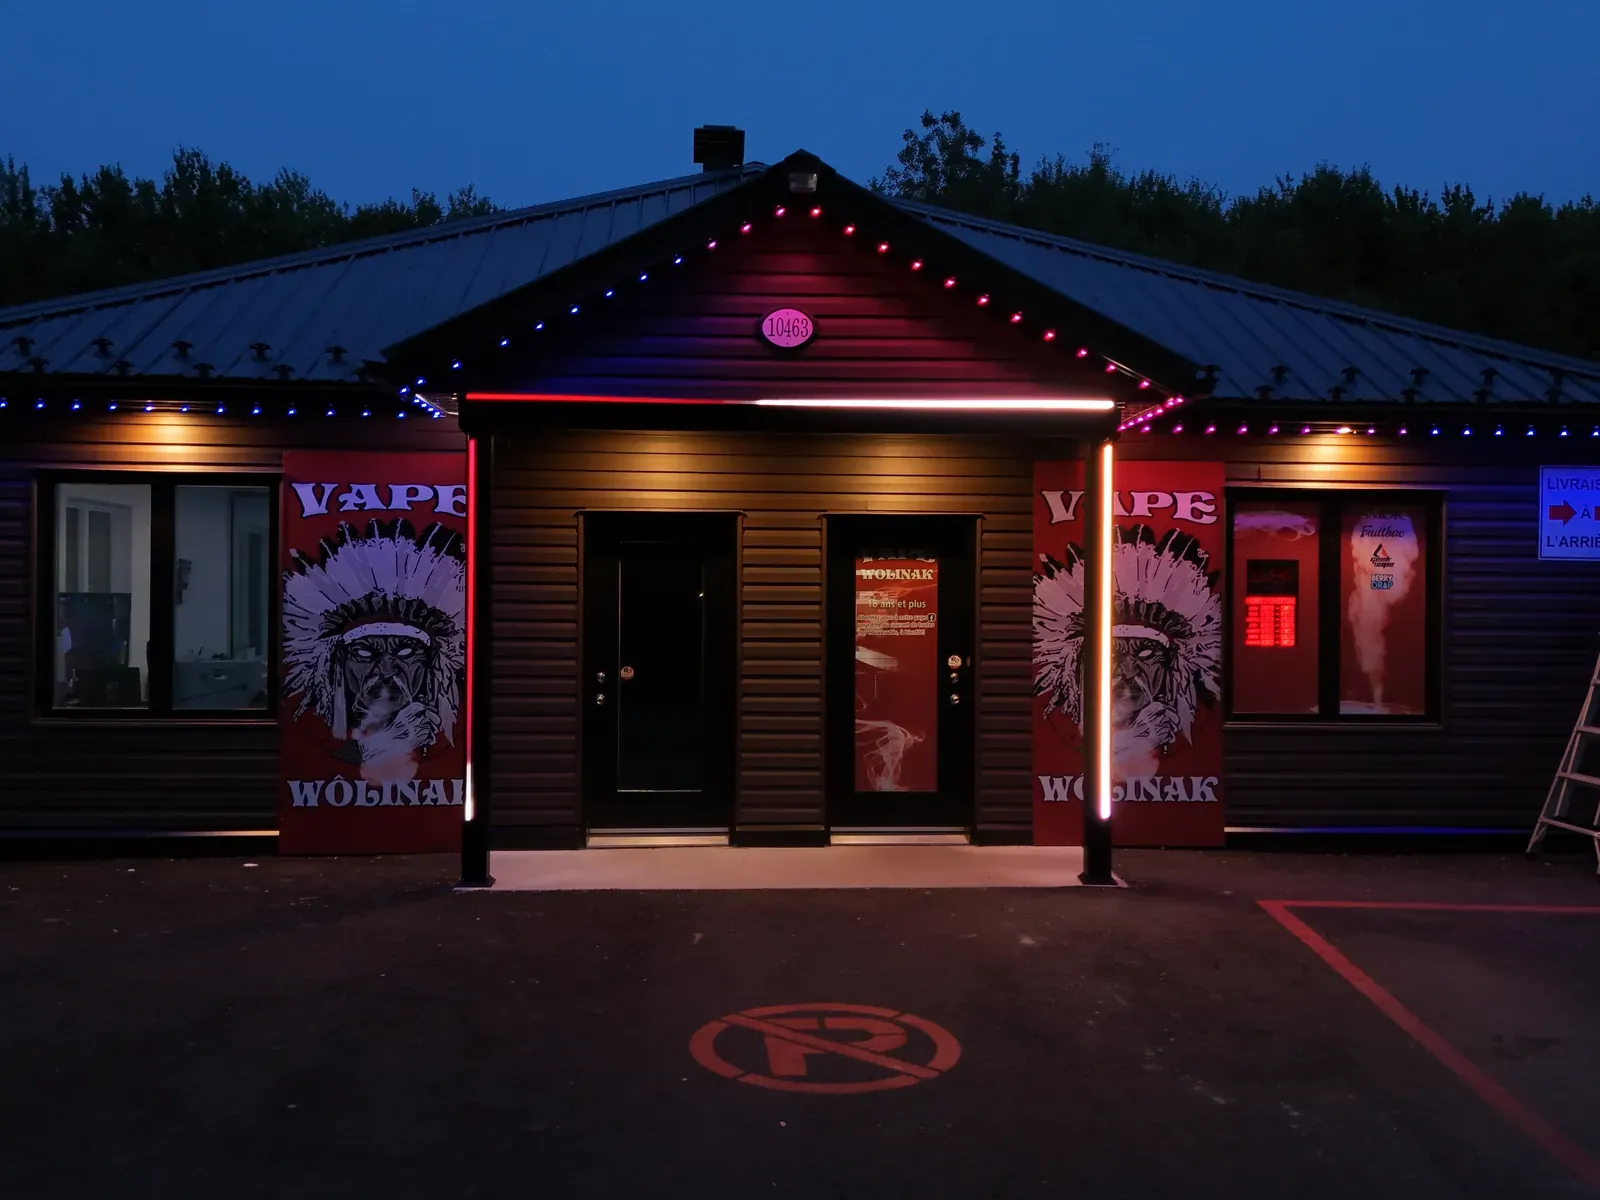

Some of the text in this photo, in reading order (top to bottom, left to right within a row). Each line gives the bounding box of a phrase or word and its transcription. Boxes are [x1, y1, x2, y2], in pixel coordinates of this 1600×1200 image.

[768, 318, 808, 337] 10463
[1580, 505, 1591, 519] À
[1360, 525, 1405, 538] Fruitbae
[868, 600, 878, 608] 18
[897, 600, 906, 608] et
[908, 600, 927, 610] plus
